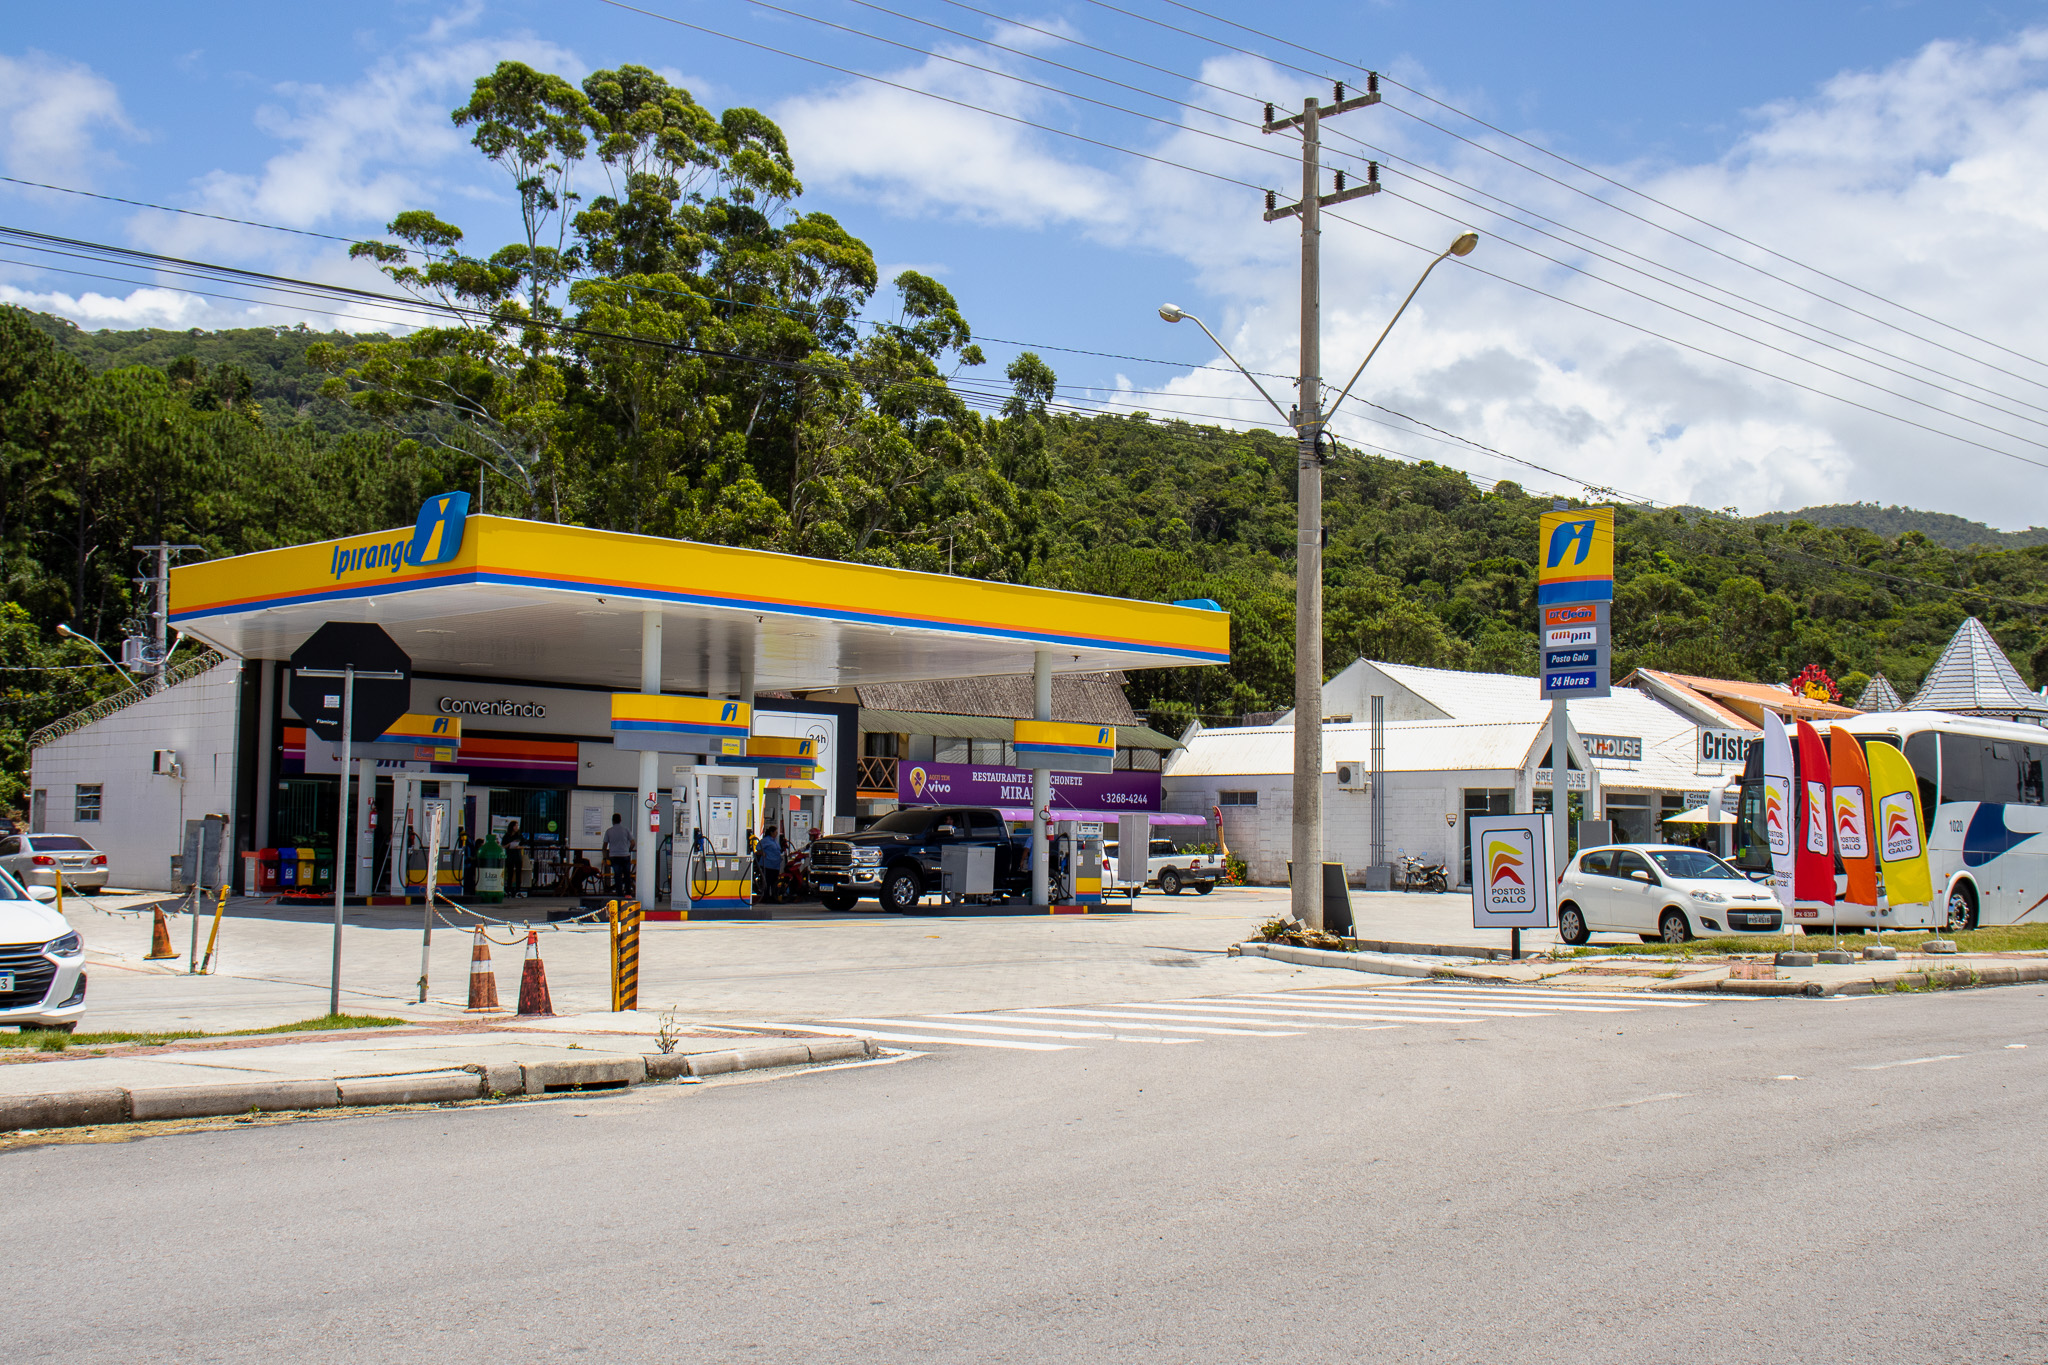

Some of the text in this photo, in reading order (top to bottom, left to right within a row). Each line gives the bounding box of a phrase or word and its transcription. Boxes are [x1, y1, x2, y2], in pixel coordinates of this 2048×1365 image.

[1549, 608, 1592, 620] DT Clean
[1551, 630, 1591, 644] ampm
[1551, 653, 1589, 664] Posto Galo
[1551, 675, 1590, 687] 24 Horas
[439, 696, 546, 718] Conveniência
[941, 774, 951, 782] TEM
[972, 771, 1027, 783] RESTAURANTE
[928, 780, 951, 793] vivo
[1106, 792, 1148, 805] 3268-4244
[1949, 819, 1964, 833] 1020
[1888, 838, 1912, 849] POSTOS
[1888, 845, 1913, 855] GALO
[484, 871, 498, 879] Liza
[1491, 887, 1526, 896] POSTOS
[1492, 896, 1527, 904] GALO
